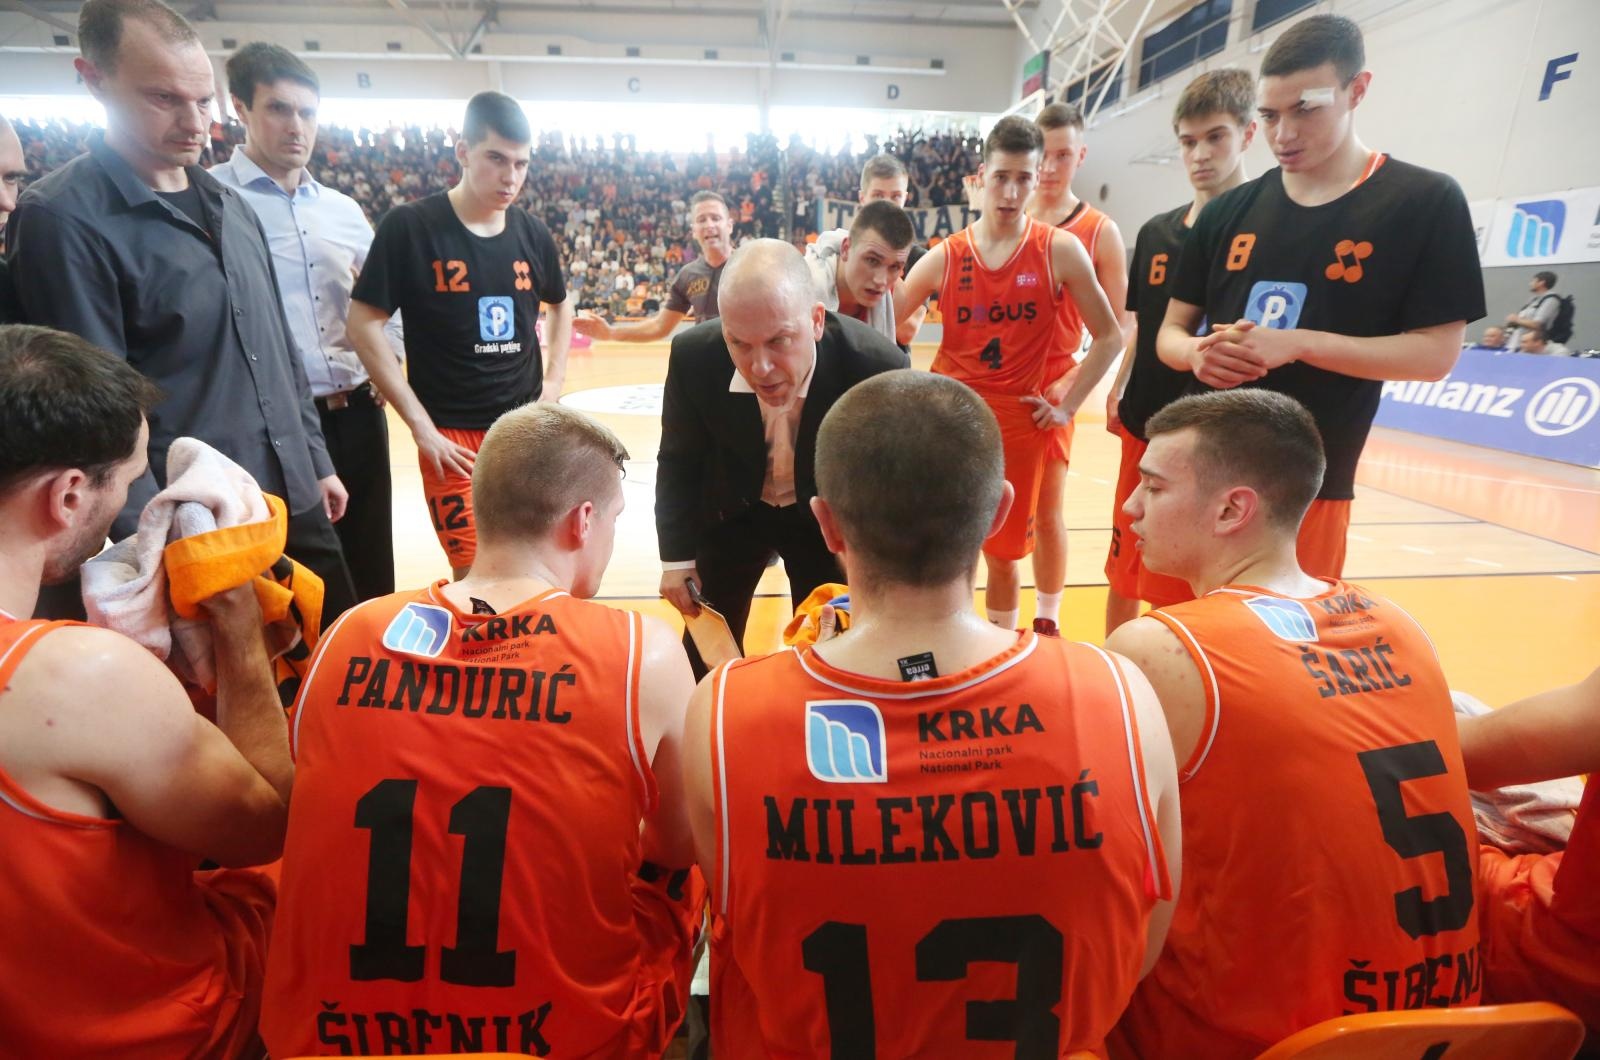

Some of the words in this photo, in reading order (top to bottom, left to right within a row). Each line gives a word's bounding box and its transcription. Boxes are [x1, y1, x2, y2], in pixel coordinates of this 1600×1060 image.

[629, 77, 641, 93] C
[888, 84, 900, 99] D
[1538, 51, 1579, 101] F
[1149, 253, 1169, 285] 6
[1226, 233, 1257, 271] 8
[432, 260, 470, 292] 12
[475, 344, 500, 353] Gradski
[980, 337, 1002, 369] 4
[462, 614, 557, 642] KRKA
[1297, 637, 1412, 698] ŠARIĆ
[337, 657, 576, 724] PANDURIĆ
[918, 704, 1045, 742] KRKA
[920, 746, 983, 760] Nacionalni
[986, 744, 1012, 757] park
[920, 762, 972, 774] National
[975, 760, 1002, 771] Park
[764, 769, 1103, 865] MILEKOVIĆ
[1357, 739, 1474, 940] 5
[350, 778, 516, 987] 11
[802, 914, 1064, 1060] 13
